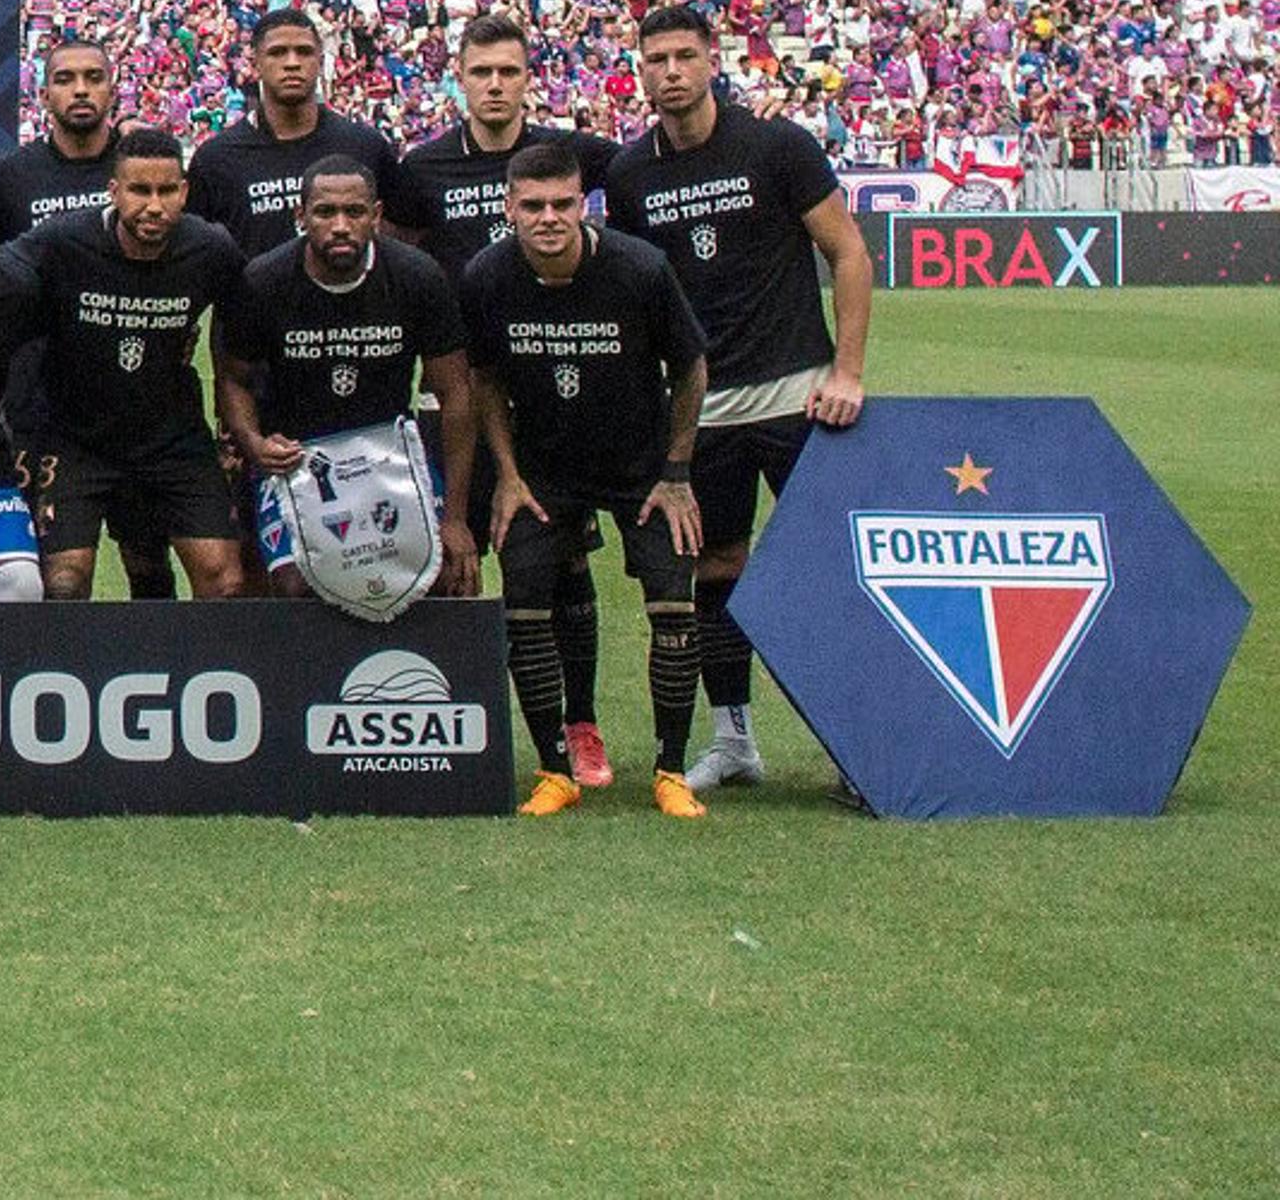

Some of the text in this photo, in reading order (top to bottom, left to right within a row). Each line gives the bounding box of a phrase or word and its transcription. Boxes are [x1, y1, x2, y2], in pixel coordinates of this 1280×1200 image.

[248, 178, 283, 197] COM
[445, 186, 479, 203] COM
[646, 177, 750, 209] COM RACISMO
[31, 196, 64, 214] COM
[250, 196, 284, 215] NÃO
[445, 203, 479, 220] NÃO
[680, 201, 712, 219] TEM
[911, 227, 1102, 288] BRAX
[80, 292, 191, 312] COM RACISMO
[116, 314, 148, 329] TEM
[508, 323, 619, 338] COM RACISMO
[285, 326, 403, 344] COM RACISMO
[325, 344, 358, 357] TEM
[546, 342, 577, 356] TEM
[867, 529, 1097, 567] FORTALEZA
[342, 756, 453, 773] ATACADISTA
